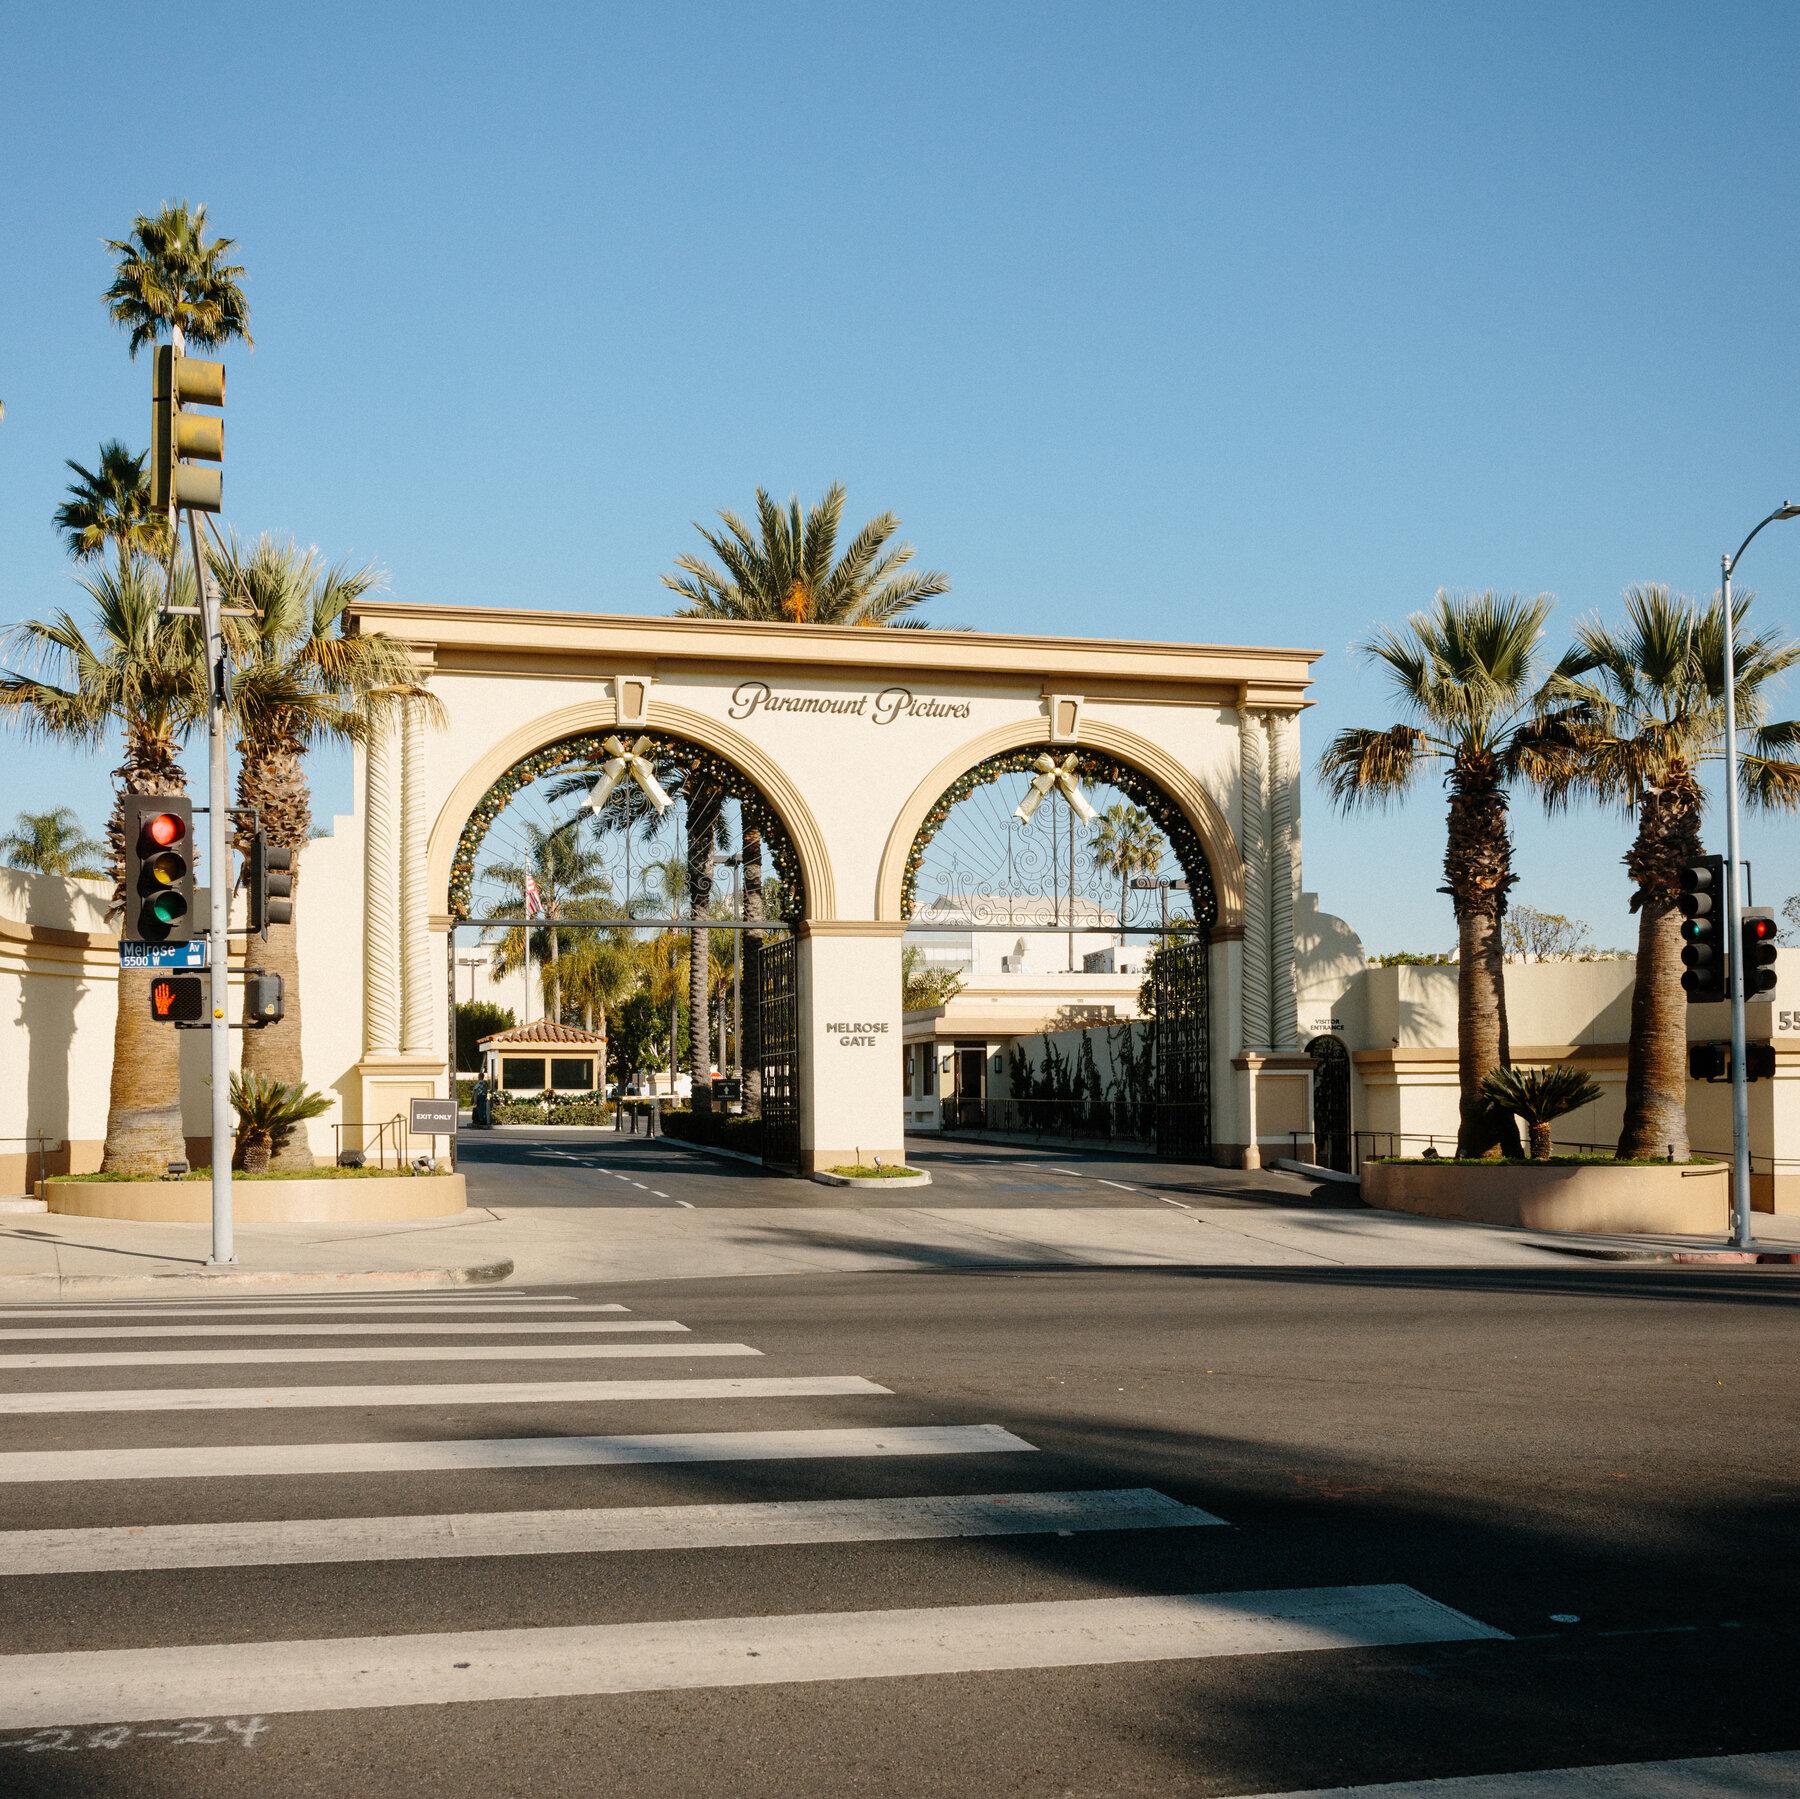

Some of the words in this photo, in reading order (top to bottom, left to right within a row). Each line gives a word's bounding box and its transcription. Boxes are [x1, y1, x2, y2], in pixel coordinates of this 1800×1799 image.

[728, 681, 867, 720] Paramount
[872, 687, 970, 725] Pictures
[124, 942, 176, 957] Melrose
[189, 942, 200, 953] Av
[124, 956, 149, 966] 5500
[152, 956, 160, 966] W
[826, 1022, 889, 1034] MELROSE
[839, 1035, 876, 1047] GATE
